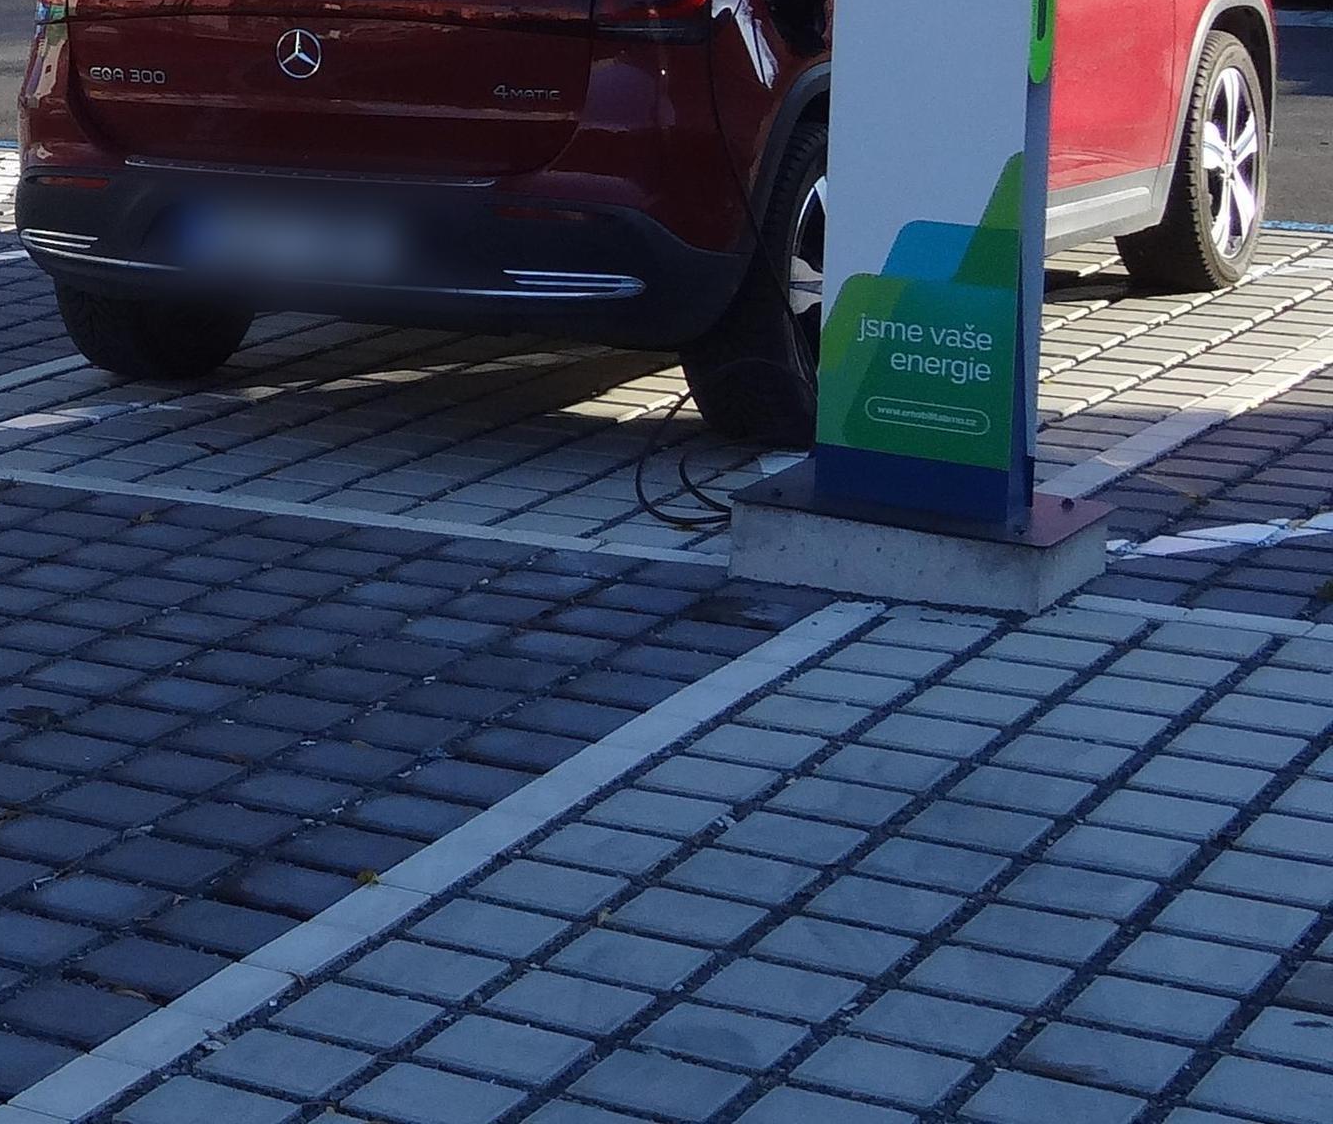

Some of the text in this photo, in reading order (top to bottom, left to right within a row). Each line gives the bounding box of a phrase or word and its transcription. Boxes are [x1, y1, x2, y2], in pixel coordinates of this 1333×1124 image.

[90, 67, 166, 84] EQA 300
[857, 313, 992, 351] jsme vaše
[890, 352, 992, 384] energie
